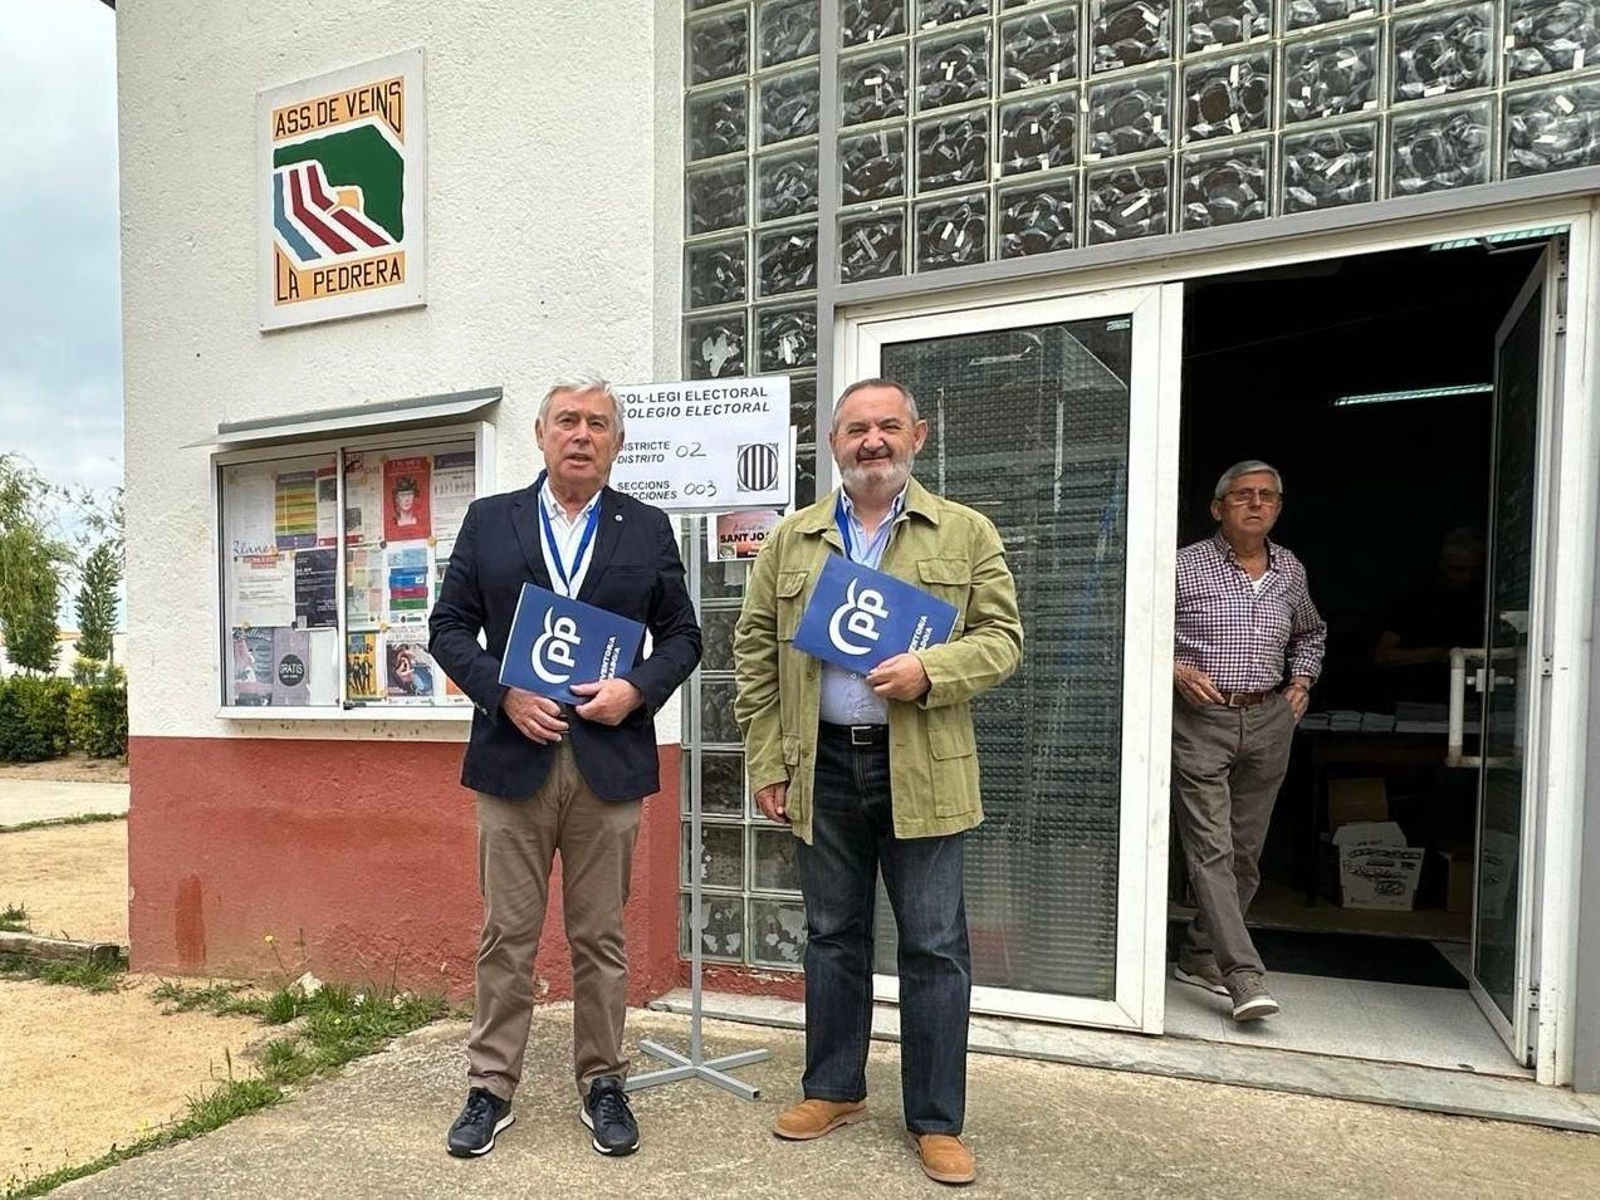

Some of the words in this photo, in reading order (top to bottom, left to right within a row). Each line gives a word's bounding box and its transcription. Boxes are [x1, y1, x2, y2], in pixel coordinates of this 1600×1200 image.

[275, 106, 315, 138] ASS.
[318, 98, 339, 126] DE
[346, 81, 402, 134] VEINS
[276, 251, 300, 301] LA
[313, 256, 401, 295] PEDRERA
[685, 387, 768, 402] ELECTORAL
[622, 406, 681, 419] OLEGIO
[685, 402, 770, 417] ELECTORAL
[623, 440, 671, 452] ISTRICTE
[675, 441, 707, 458] 02
[617, 454, 665, 464] DISTRITO
[617, 481, 671, 491] SECCIONS
[683, 480, 717, 497] 003
[719, 533, 749, 543] SANT
[750, 531, 769, 541] JO
